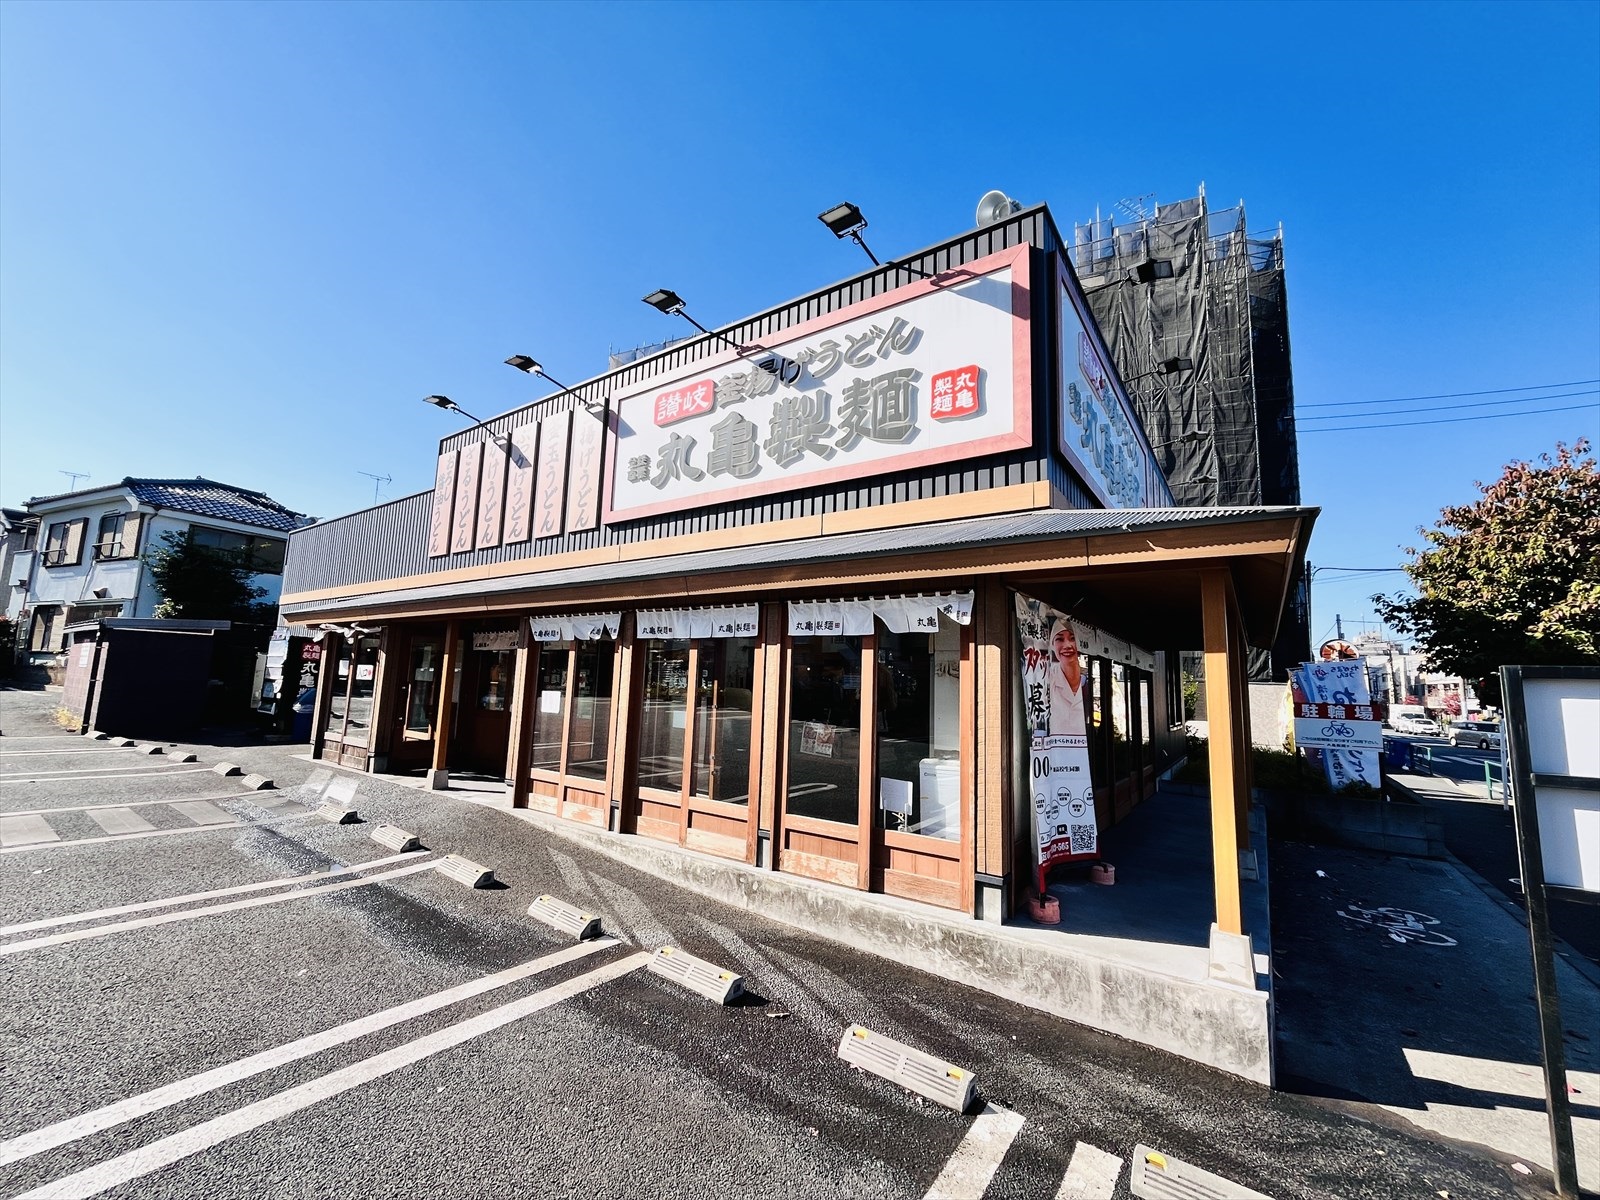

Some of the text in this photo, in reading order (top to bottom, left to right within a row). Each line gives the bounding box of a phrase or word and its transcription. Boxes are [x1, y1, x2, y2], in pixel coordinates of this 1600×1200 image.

[715, 317, 923, 408] 釜揚げうどん
[657, 385, 711, 421] 讃岐
[932, 376, 953, 414] 製麺
[954, 372, 975, 408] 丸亀
[651, 369, 924, 489] 丸亀製麺
[717, 622, 751, 634] 丸亀製麺
[795, 620, 834, 632] 丸亀製麺
[1301, 704, 1374, 720] 駐輪場
